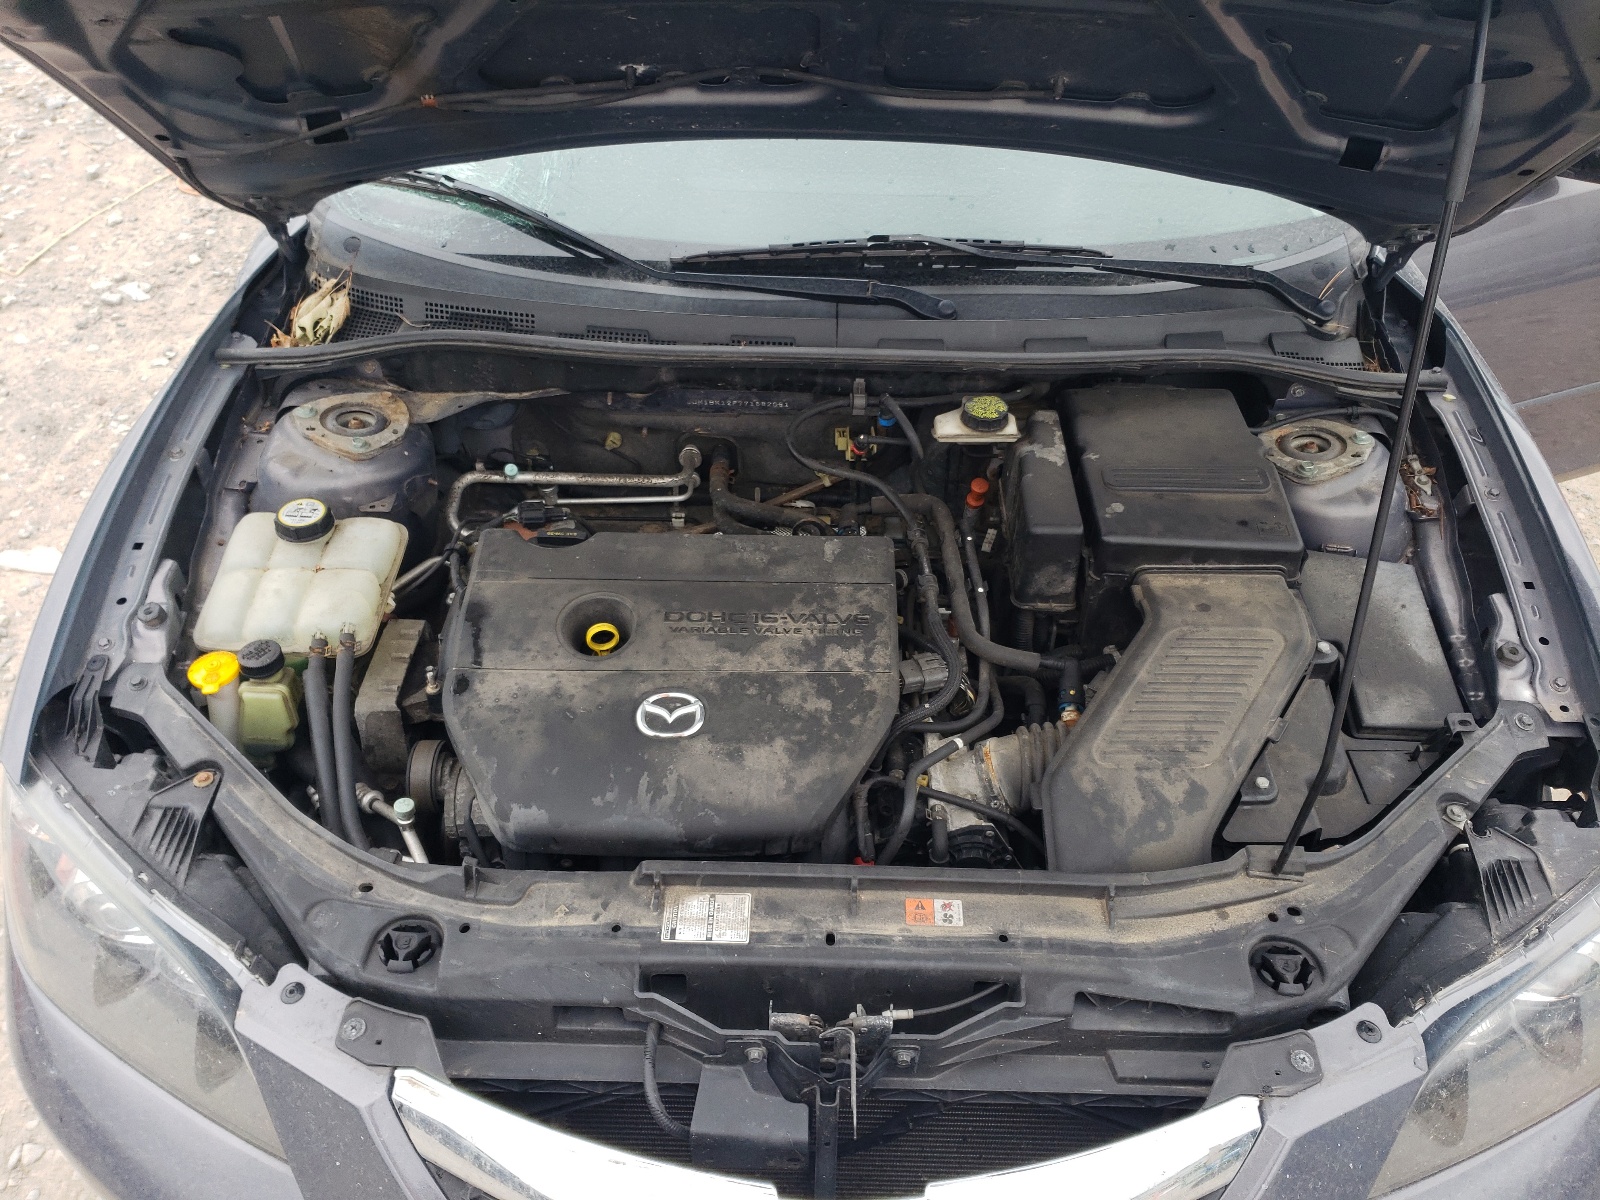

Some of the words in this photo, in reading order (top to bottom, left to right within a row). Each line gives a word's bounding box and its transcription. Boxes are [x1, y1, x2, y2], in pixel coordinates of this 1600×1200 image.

[663, 611, 748, 624] DOHC
[752, 612, 871, 626] 16-VALVE
[669, 625, 749, 635] VARIABLE
[752, 626, 802, 636] VALVE
